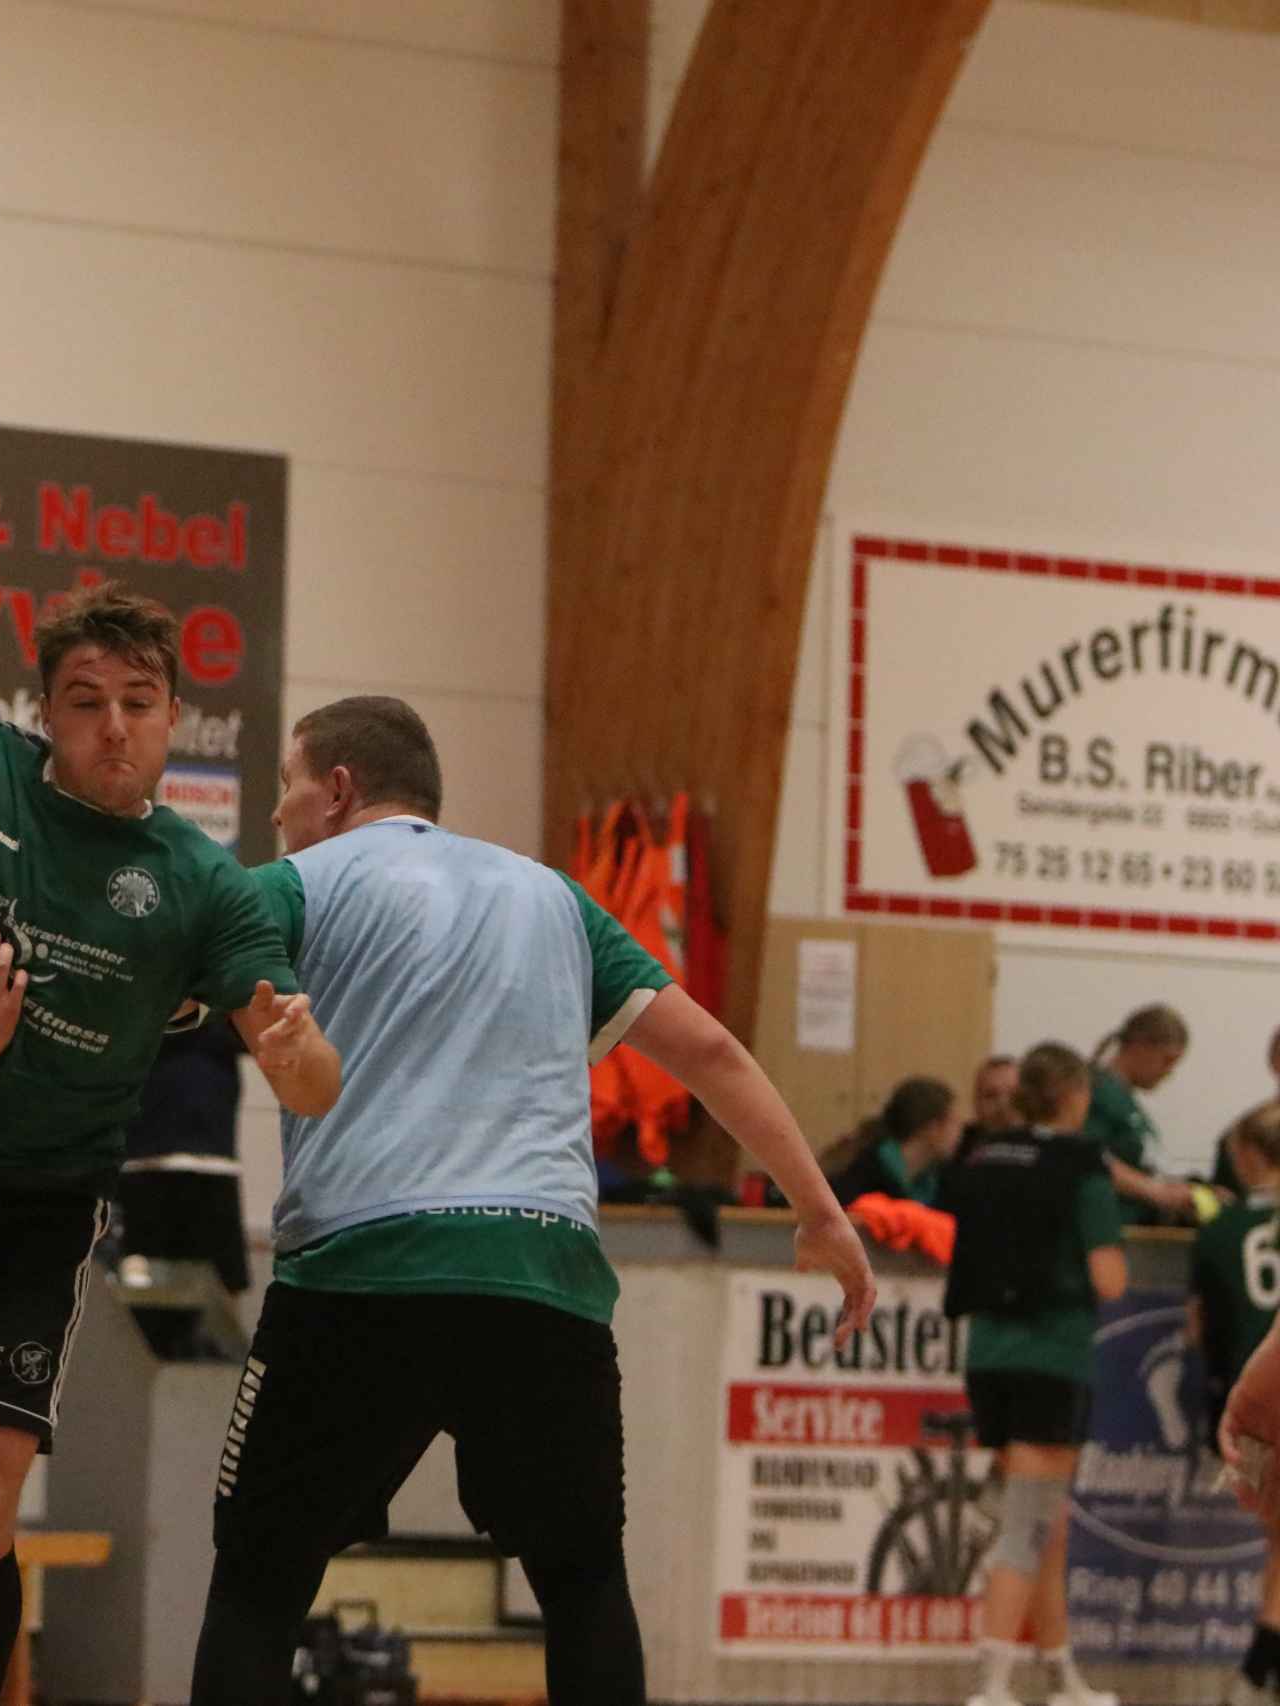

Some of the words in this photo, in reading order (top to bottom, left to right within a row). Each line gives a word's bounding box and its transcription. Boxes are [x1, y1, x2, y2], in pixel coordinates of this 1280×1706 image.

[38, 481, 247, 570] Nebel
[966, 603, 1280, 775] Murerfirm
[1039, 734, 1128, 788] B.S.
[1145, 743, 1263, 798] Riber
[753, 1386, 884, 1443] Service
